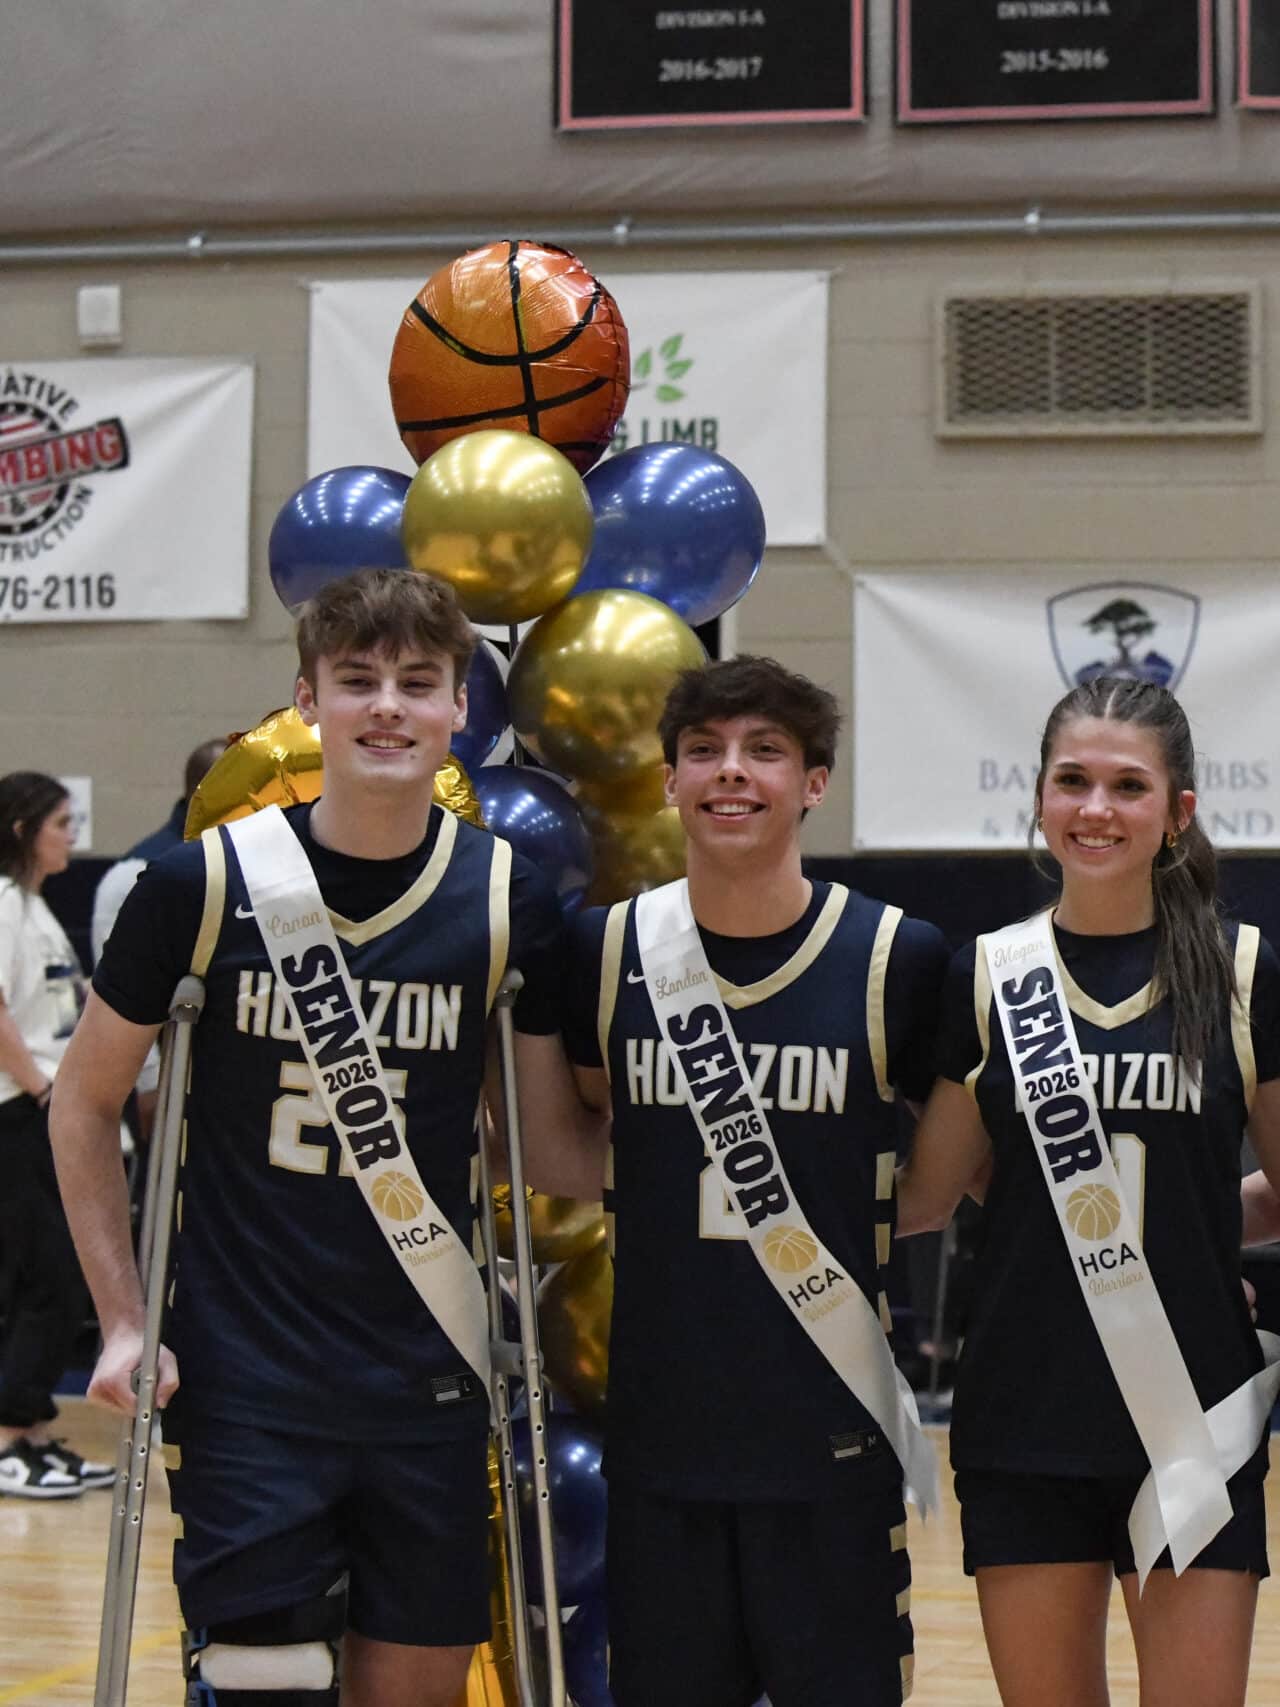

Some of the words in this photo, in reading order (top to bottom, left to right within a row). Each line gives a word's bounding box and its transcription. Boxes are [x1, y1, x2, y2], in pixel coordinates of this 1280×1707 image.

[658, 56, 763, 82] 2016-2017
[999, 48, 1110, 73] 2015-2016
[0, 370, 80, 420] ATIVE
[322, 1058, 377, 1095] 2026
[1025, 1067, 1080, 1103] 2026
[710, 1113, 763, 1151] 2026
[392, 1222, 448, 1251] HCA
[1078, 1243, 1138, 1277] HCA
[788, 1267, 844, 1308] HCA
